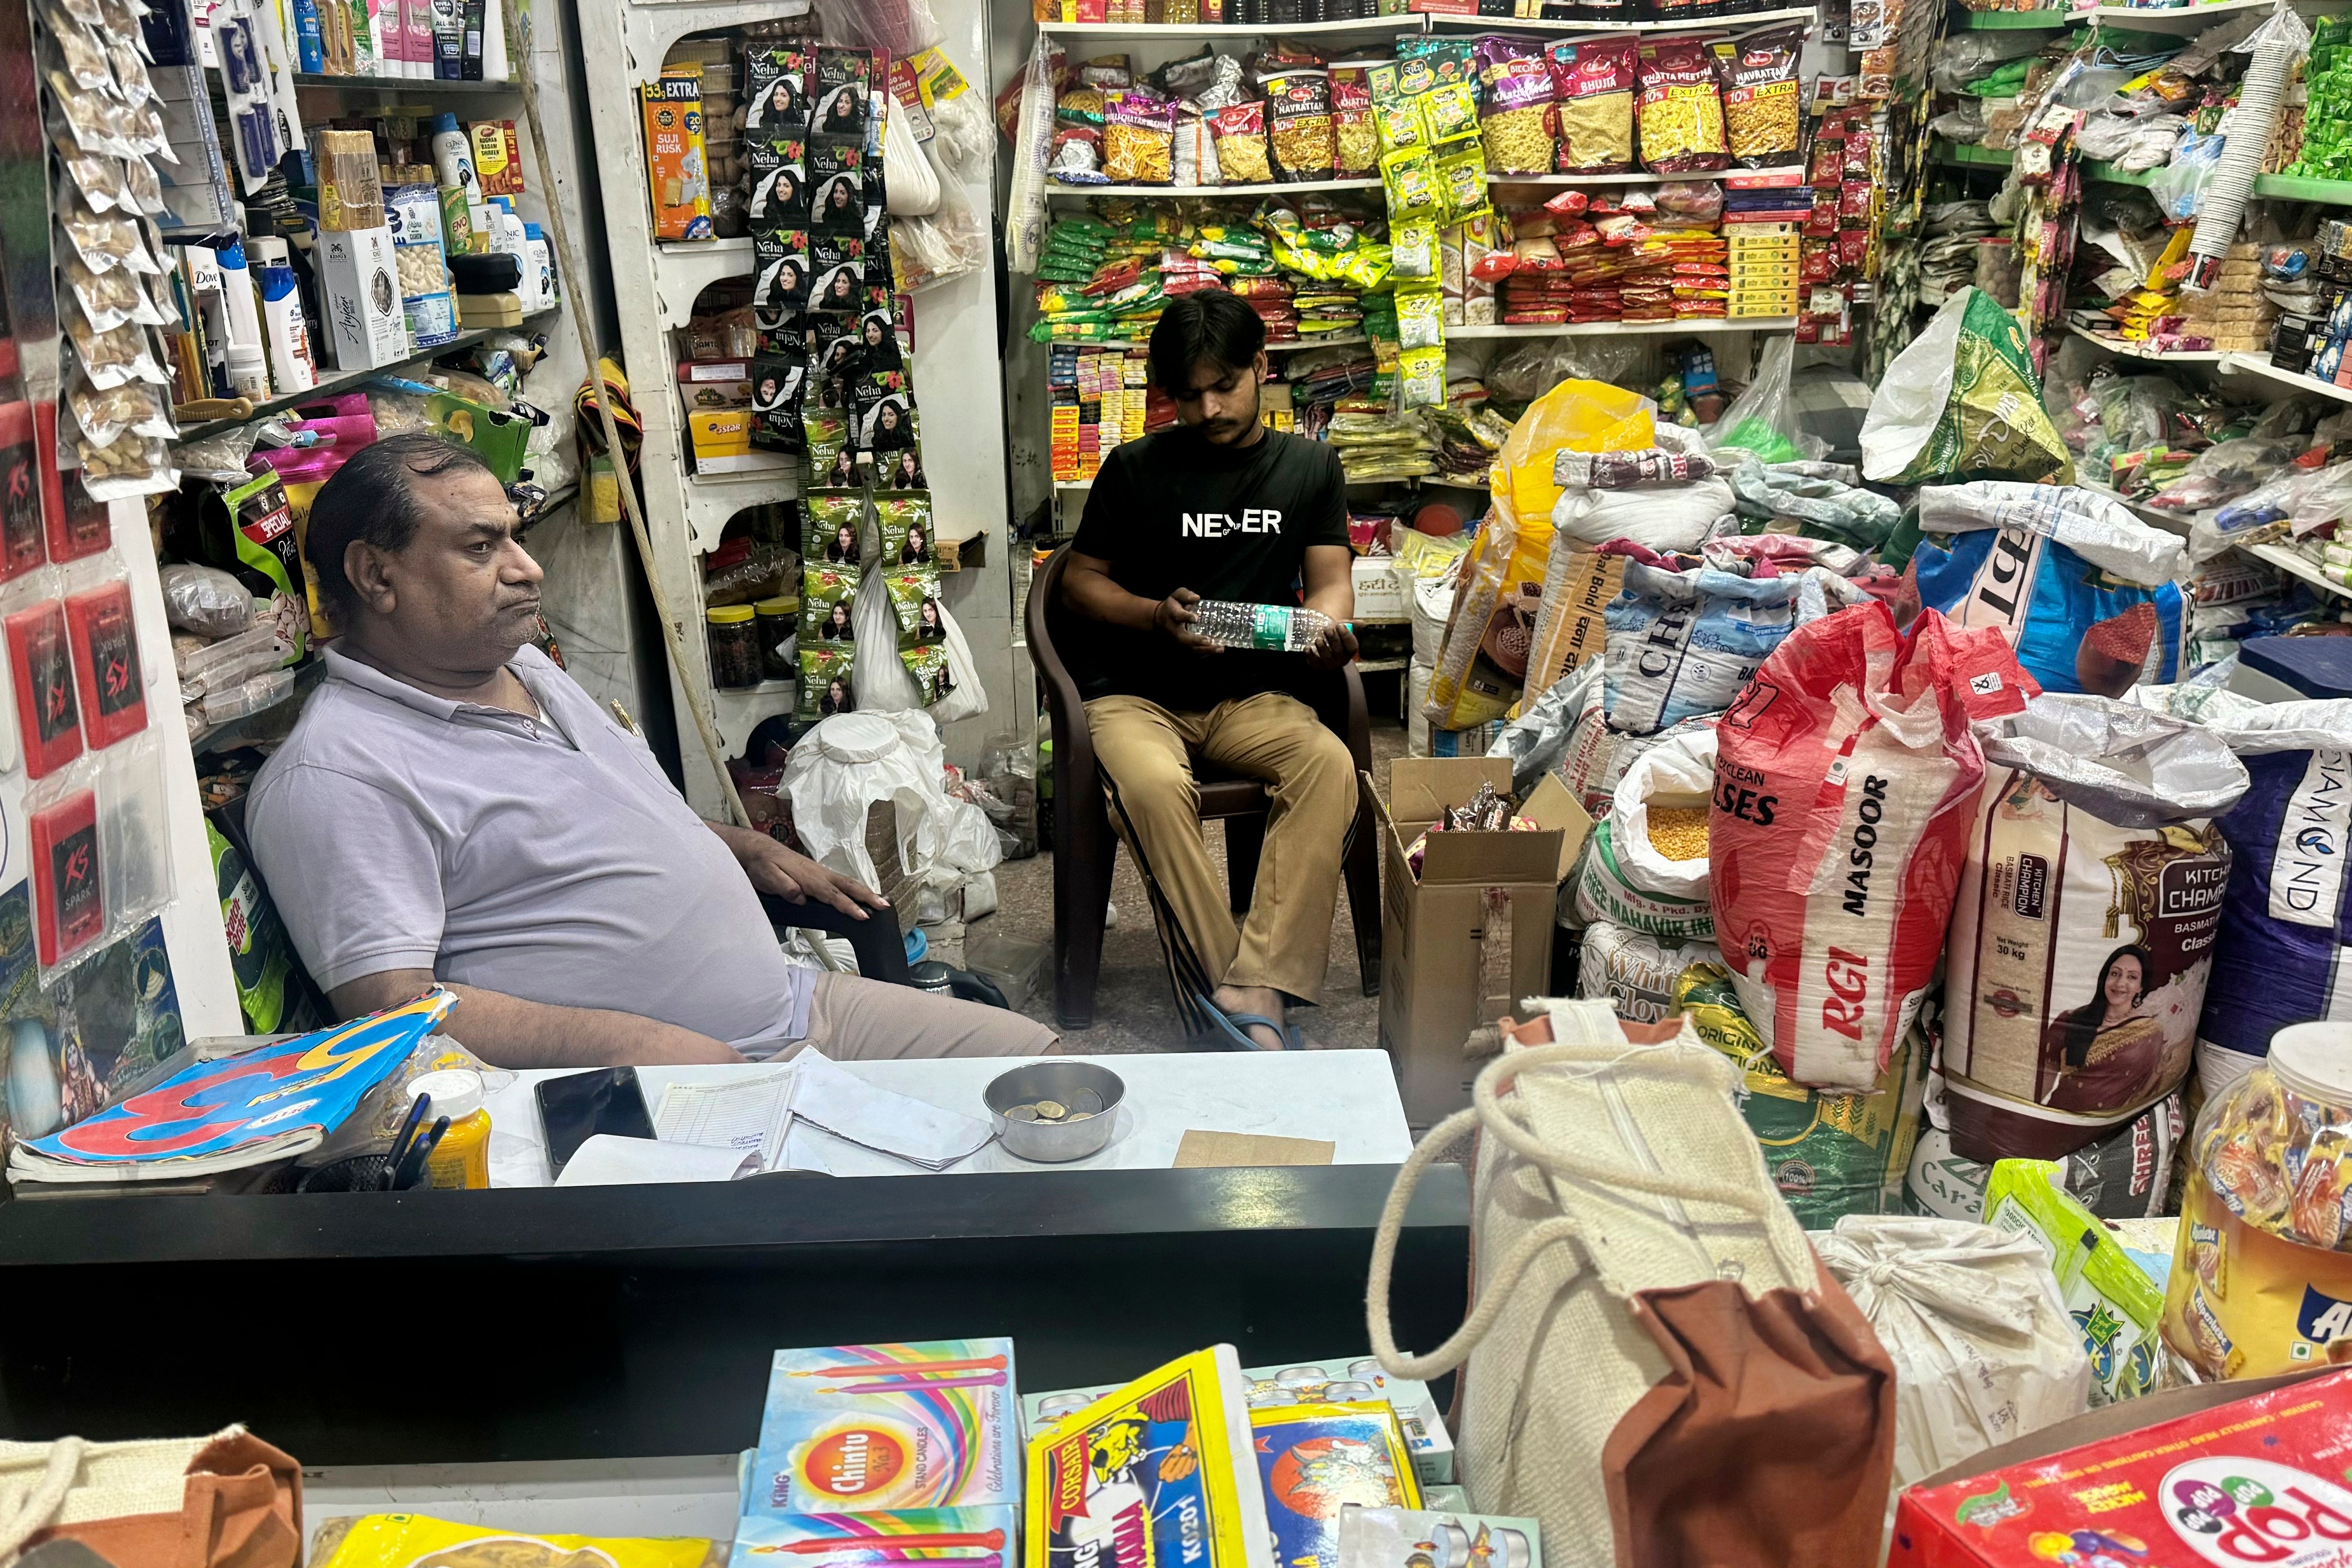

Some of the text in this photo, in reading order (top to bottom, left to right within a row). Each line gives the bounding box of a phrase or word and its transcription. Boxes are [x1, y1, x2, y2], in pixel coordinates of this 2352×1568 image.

[751, 62, 779, 75] Neha
[821, 66, 846, 81] Neha
[1642, 66, 1713, 85] KHATTA MEETHA
[1736, 66, 1792, 83] NAVRATTAN
[667, 82, 699, 97] EXTRA
[1580, 77, 1617, 92] BHUJIA
[1729, 83, 1794, 103] 10% EXTRA
[905, 92, 916, 101] USE
[1340, 97, 1369, 108] KHATTA
[1644, 86, 1712, 103] 10% EXTRA
[1278, 102, 1325, 114] NAVRATTAN
[1297, 117, 1330, 127] EXTRA
[445, 139, 466, 148] CLINIC
[657, 134, 679, 143] SUJI
[656, 145, 682, 153] RUSK
[752, 153, 780, 164] Neha
[813, 157, 838, 169] Neha
[1451, 169, 1473, 182] Radha
[206, 186, 217, 220] CLASSIC
[452, 215, 468, 231] ENO
[756, 241, 784, 253] Neha
[815, 247, 841, 260] Neha
[195, 271, 218, 284] Dove
[818, 323, 841, 336] Neha
[775, 331, 801, 346] Neha
[856, 384, 882, 398] Neha
[1997, 380, 2009, 390] TM
[716, 423, 741, 435] 5Star
[769, 414, 794, 428] Neha
[812, 446, 835, 455] Neha
[260, 511, 291, 538] SPECIAL
[884, 525, 905, 535] Neha
[1584, 576, 1605, 606] Bold
[807, 598, 830, 609] Neha
[898, 601, 918, 611] Neha
[101, 632, 127, 652] SPARK
[804, 675, 827, 685] Neha
[1728, 760, 1765, 787] CLEAN
[1842, 774, 1888, 918] MASOOR
[1992, 863, 2003, 898] Classic
[2001, 855, 2015, 909] BASMATI RICE
[2017, 857, 2033, 914] CHAMPION
[2031, 868, 2044, 907] KITCHEN
[65, 889, 92, 911] SPARK
[1624, 889, 1645, 909] Mfg.
[1649, 901, 1659, 912] &
[1662, 904, 1689, 915] Pkd.
[1610, 895, 1684, 936] MAHAVIR
[231, 915, 247, 954] Brite
[1996, 936, 2029, 948] Net Weight
[1997, 945, 2025, 961] 30 kg
[1607, 948, 1678, 996] Whit
[1605, 979, 1671, 1024] Glov
[1822, 946, 1868, 1041] RGI
[1698, 1025, 1757, 1051] ORIGIN
[257, 1105, 312, 1126] DELTA
[2195, 1296, 2227, 1347] Alpenliebe
[2280, 1400, 2324, 1418] CAUTION
[2220, 1415, 2275, 1436] CAREFULLY
[984, 1390, 1004, 1493] Celebrations are Forever
[2189, 1431, 2219, 1446] READ
[2155, 1440, 2190, 1455] OTHER
[831, 1434, 869, 1493] Chintu
[915, 1426, 929, 1490] STAND CANDLES
[2102, 1449, 2155, 1468] CAUTIONS
[1060, 1437, 1081, 1511] CORSAIR
[2084, 1464, 2101, 1474] ON
[2191, 1486, 2223, 1508] POP
[2232, 1481, 2264, 1503] POP
[2087, 1491, 2147, 1514] MICKEY
[2184, 1510, 2213, 1531] POP
